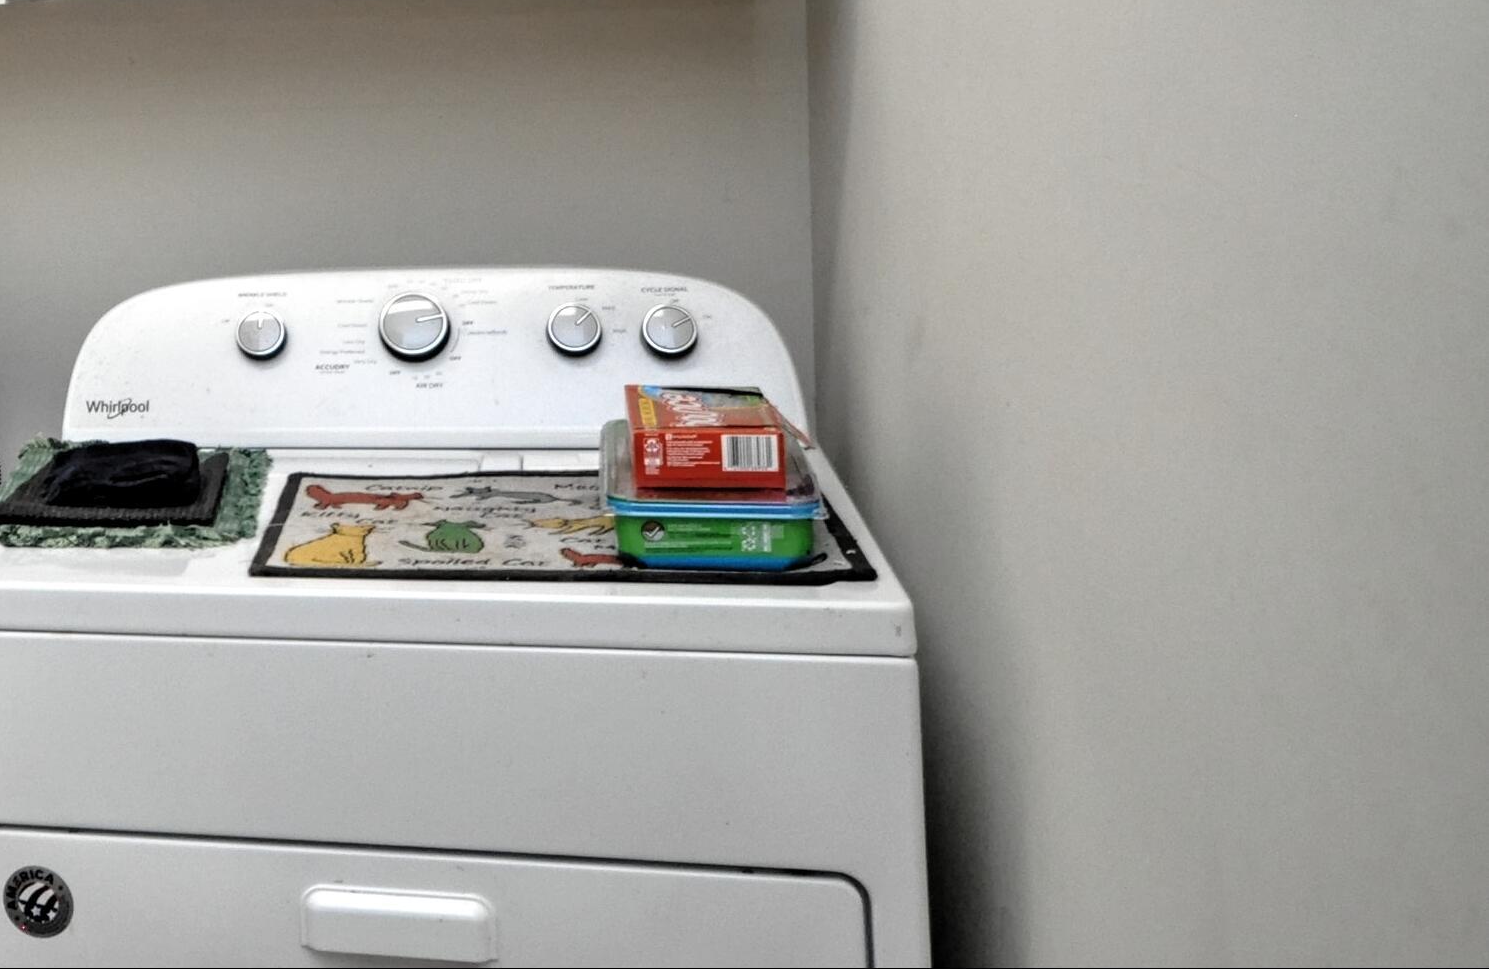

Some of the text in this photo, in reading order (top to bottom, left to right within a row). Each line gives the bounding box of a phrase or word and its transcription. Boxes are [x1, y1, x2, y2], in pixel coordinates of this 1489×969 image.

[86, 399, 150, 417] Whirlpool
[434, 505, 537, 514] Naughty
[301, 510, 360, 520] Kitty
[398, 558, 491, 567] Spoiled
[502, 558, 552, 567] Cat
[5, 869, 54, 910] AMERICA
